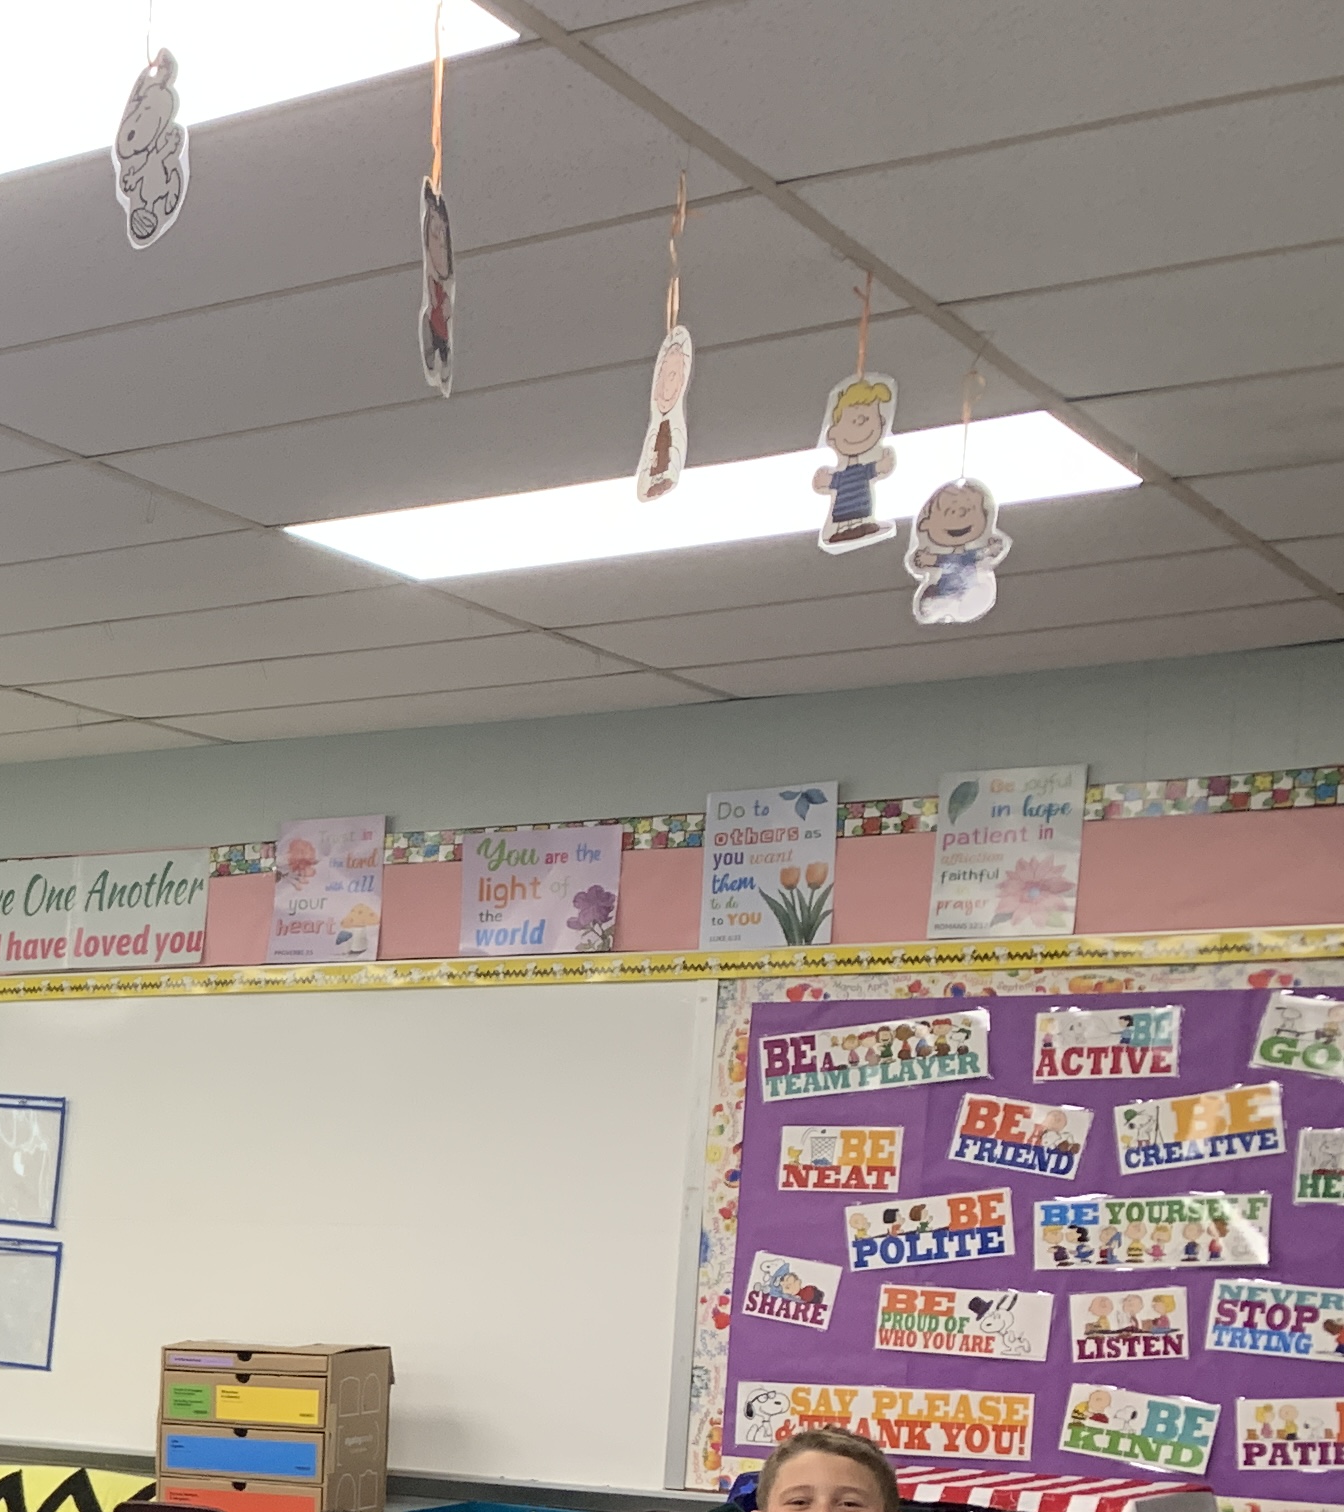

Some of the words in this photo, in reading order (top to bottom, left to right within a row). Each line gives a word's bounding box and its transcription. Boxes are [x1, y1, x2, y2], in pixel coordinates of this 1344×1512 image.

[718, 802, 745, 820] Do
[754, 800, 769, 817] to
[991, 803, 1010, 818] in
[1023, 795, 1072, 823] hope
[714, 827, 799, 847] others
[804, 829, 822, 839] as
[943, 826, 1028, 850] patient
[1039, 825, 1053, 840] in
[477, 838, 540, 871] You
[545, 852, 568, 865] are
[576, 843, 601, 863] the
[713, 852, 744, 870] you
[749, 849, 793, 865] want
[23, 873, 76, 916] One
[85, 860, 204, 912] Another
[348, 875, 375, 893] all
[712, 873, 756, 894] them
[941, 869, 999, 884] faithful
[288, 898, 327, 915] your
[478, 875, 542, 909] light
[550, 875, 570, 899] of
[479, 910, 502, 923] the
[712, 915, 723, 926] to
[727, 912, 761, 926] YOU
[936, 899, 990, 916] prayer
[276, 917, 336, 936] heart
[476, 919, 546, 946] world
[6, 931, 67, 961] have
[73, 924, 151, 958] loved
[155, 930, 203, 962] you
[1130, 1012, 1172, 1047] BE
[763, 1035, 816, 1077] BE
[820, 1052, 839, 1072] A
[1036, 1046, 1172, 1077] ACTIVE
[766, 1068, 850, 1097] TEAM
[858, 1052, 981, 1086] PLAYER
[962, 1099, 1033, 1143] BE
[1027, 1125, 1045, 1146] A
[1171, 1086, 1275, 1143] BE
[838, 1130, 896, 1166] BE
[955, 1134, 1075, 1175] FRIEND
[1125, 1127, 1279, 1169] CREATIVE
[782, 1164, 896, 1190] NEAT
[947, 1193, 1006, 1230] BE
[1040, 1202, 1099, 1226] BE
[1105, 1197, 1268, 1225] YOURSEF
[852, 1226, 1005, 1268] POLITE
[745, 1290, 828, 1326] SHARE
[883, 1288, 956, 1316] BE
[1218, 1284, 1344, 1310] NEVER
[881, 1312, 940, 1333] PROUD
[945, 1317, 970, 1334] OF
[1215, 1300, 1320, 1333] STOP
[879, 1329, 917, 1348] WHO
[923, 1332, 956, 1351] YOU
[959, 1334, 995, 1353] ARE
[1077, 1334, 1184, 1360] LISTEN
[1213, 1325, 1313, 1355] TRYING
[790, 1387, 858, 1418] SAY
[871, 1390, 1029, 1425] PLEASE
[934, 1422, 1025, 1455] YOU!
[1141, 1400, 1216, 1447] BE
[1065, 1423, 1204, 1468] KIND
